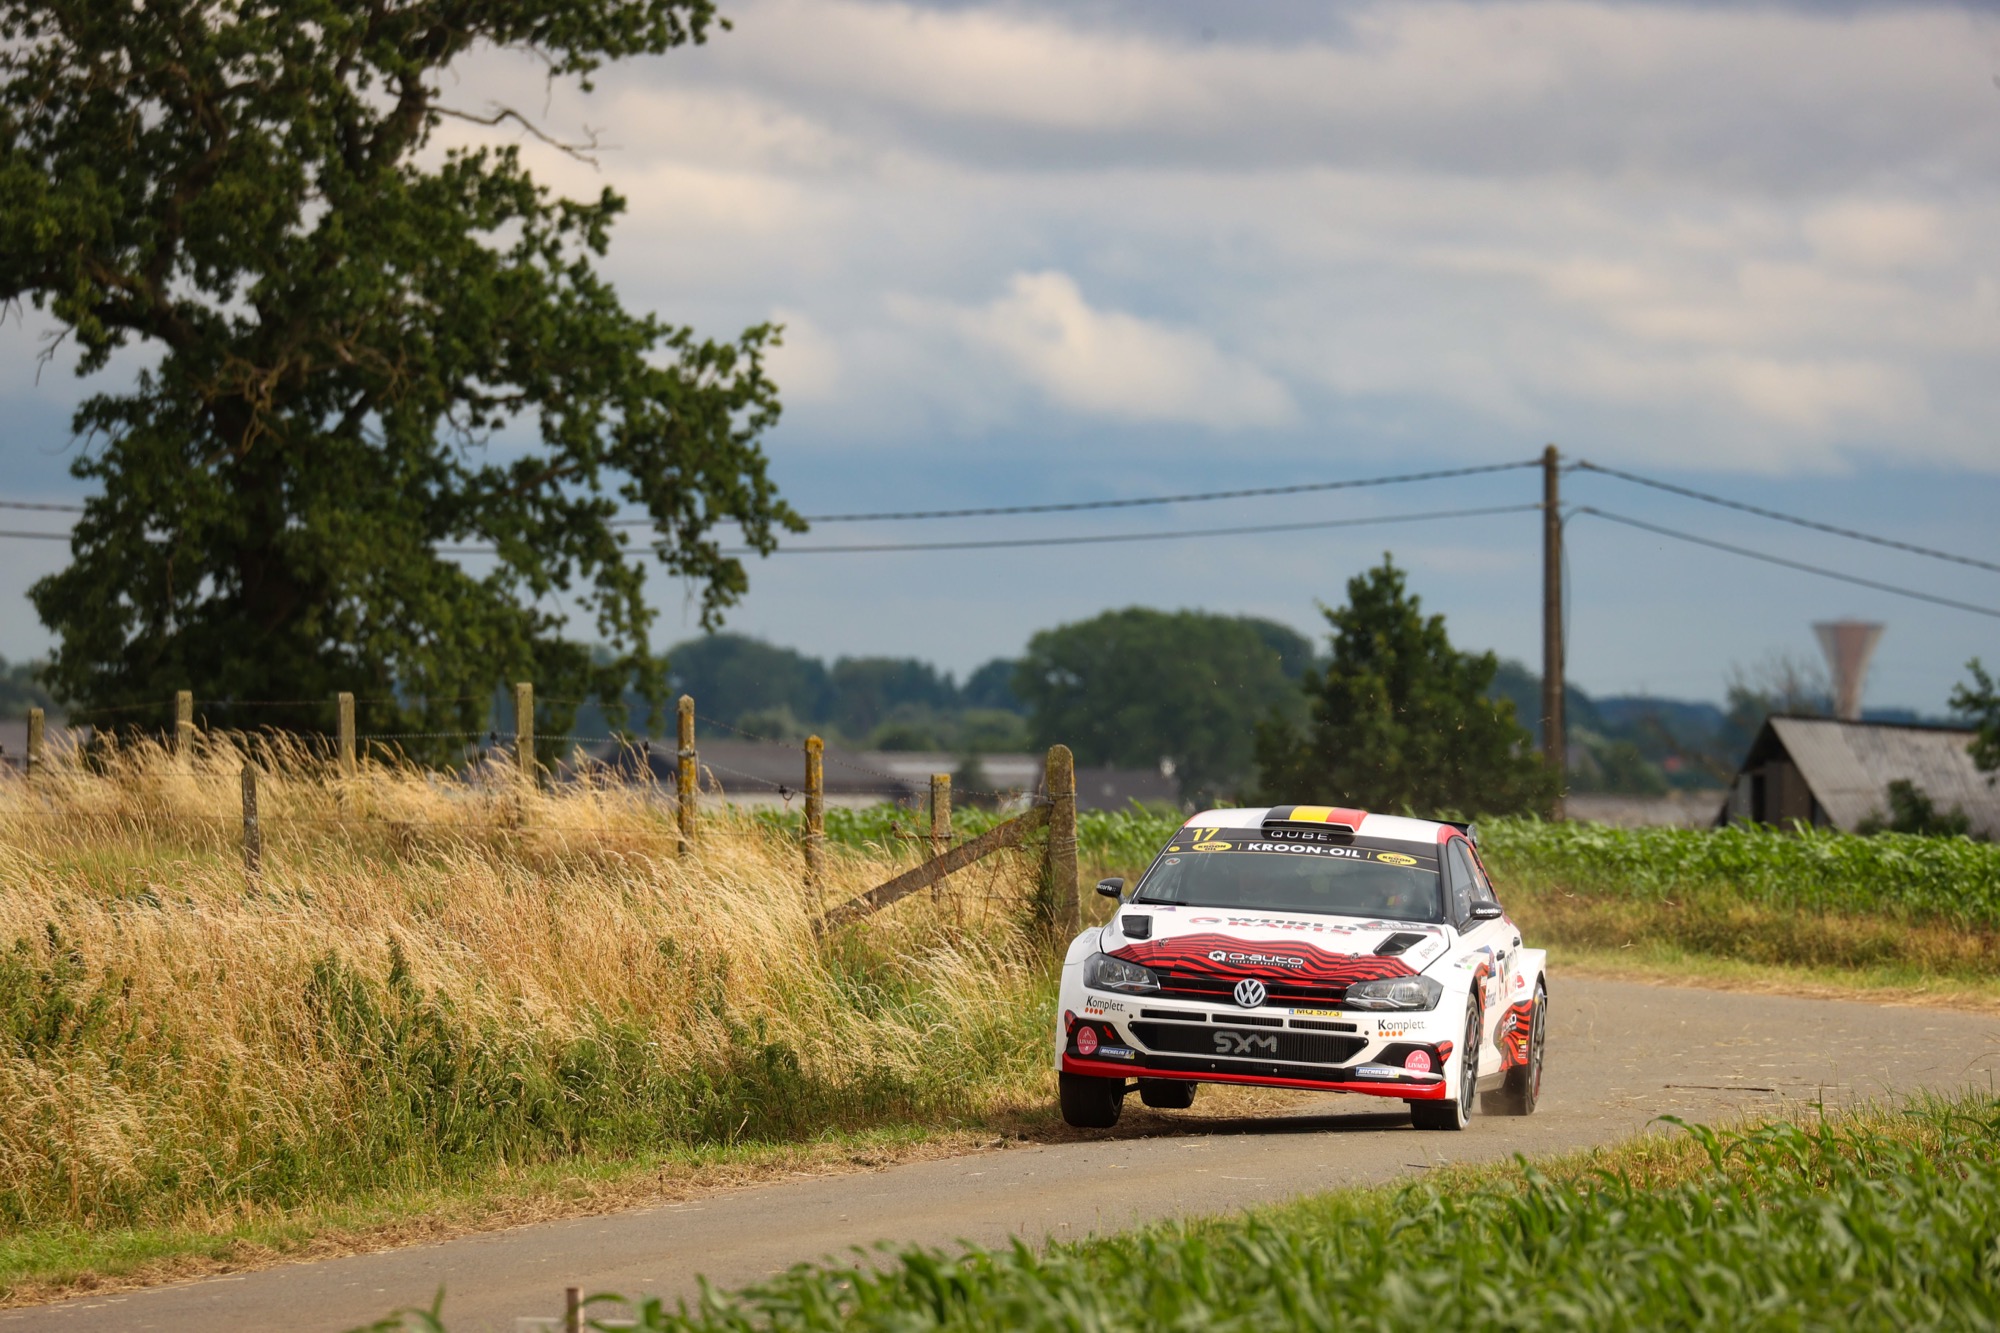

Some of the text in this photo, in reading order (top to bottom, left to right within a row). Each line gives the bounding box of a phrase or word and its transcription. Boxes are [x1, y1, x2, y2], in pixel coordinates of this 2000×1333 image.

[1192, 827, 1220, 842] 17
[1248, 843, 1360, 858] KROON-OIL
[1100, 1048, 1126, 1056] MICHELIN
[1358, 1068, 1389, 1076] MICHELIN
